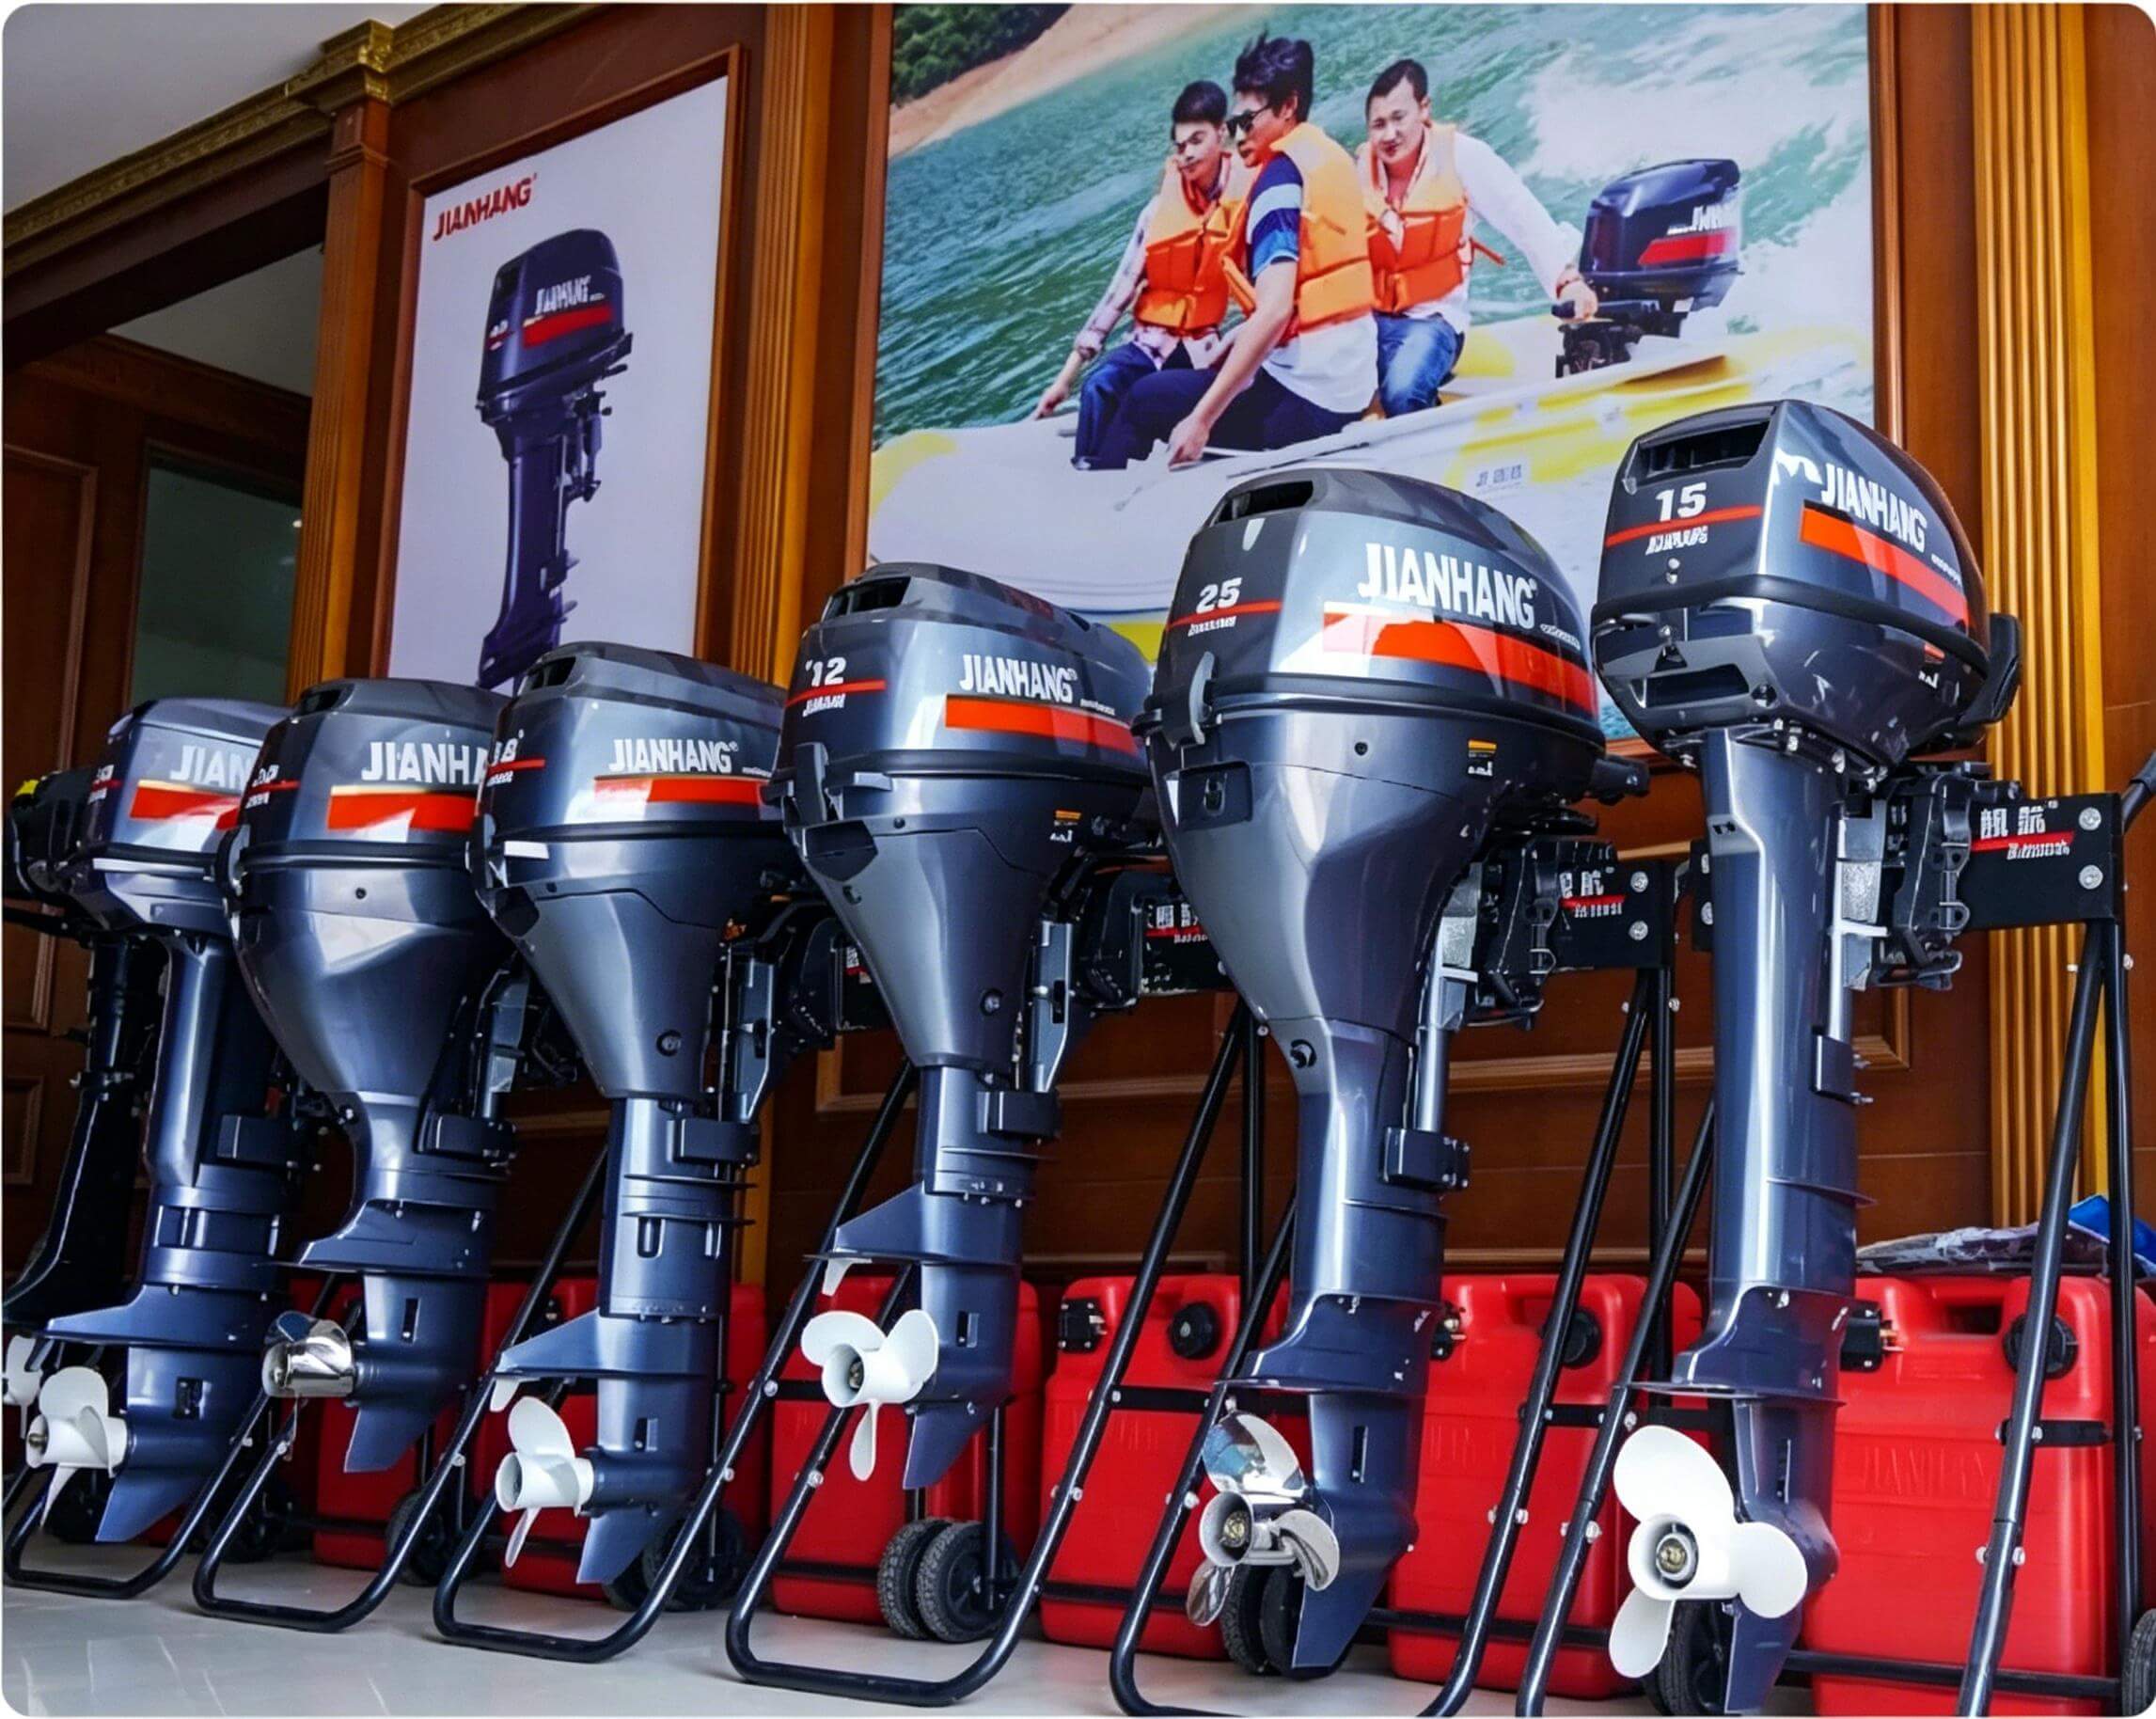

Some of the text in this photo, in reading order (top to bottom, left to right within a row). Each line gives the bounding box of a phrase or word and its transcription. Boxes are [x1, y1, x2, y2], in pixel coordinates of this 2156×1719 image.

[433, 177, 532, 241] JIANHANG
[1656, 481, 1707, 523] 15
[1821, 463, 1928, 553] JIANHANG
[1196, 576, 1242, 614] 25
[1358, 543, 1535, 629] JIANHANG
[810, 656, 846, 687] 12
[959, 654, 1073, 703] JIANHANG
[609, 738, 732, 773] JIANHANG
